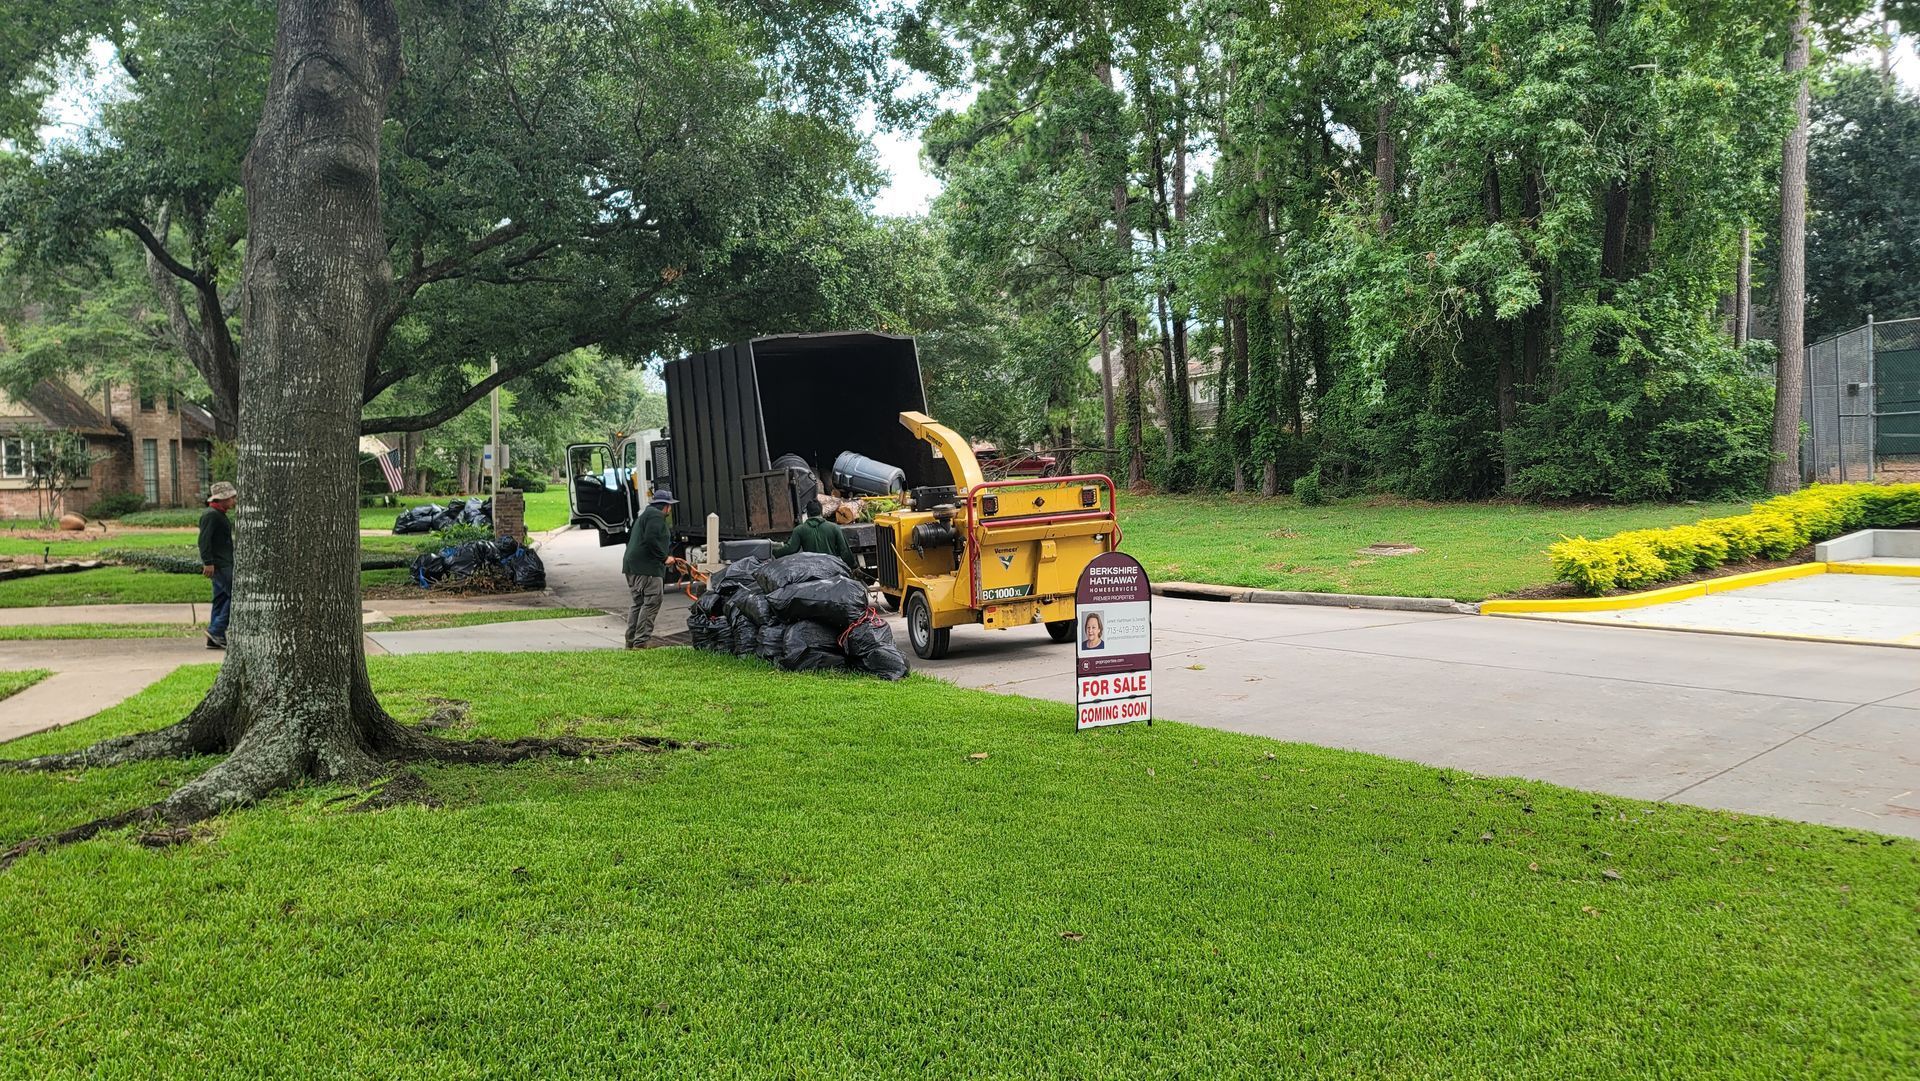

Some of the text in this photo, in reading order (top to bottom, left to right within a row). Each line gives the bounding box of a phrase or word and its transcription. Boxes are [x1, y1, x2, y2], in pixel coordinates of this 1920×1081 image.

[1089, 566, 1138, 576] BERKSHIRE
[1089, 576, 1138, 586] HATHAWAY
[1082, 675, 1147, 697] FOR SALE
[1080, 701, 1147, 724] COMING SOON
